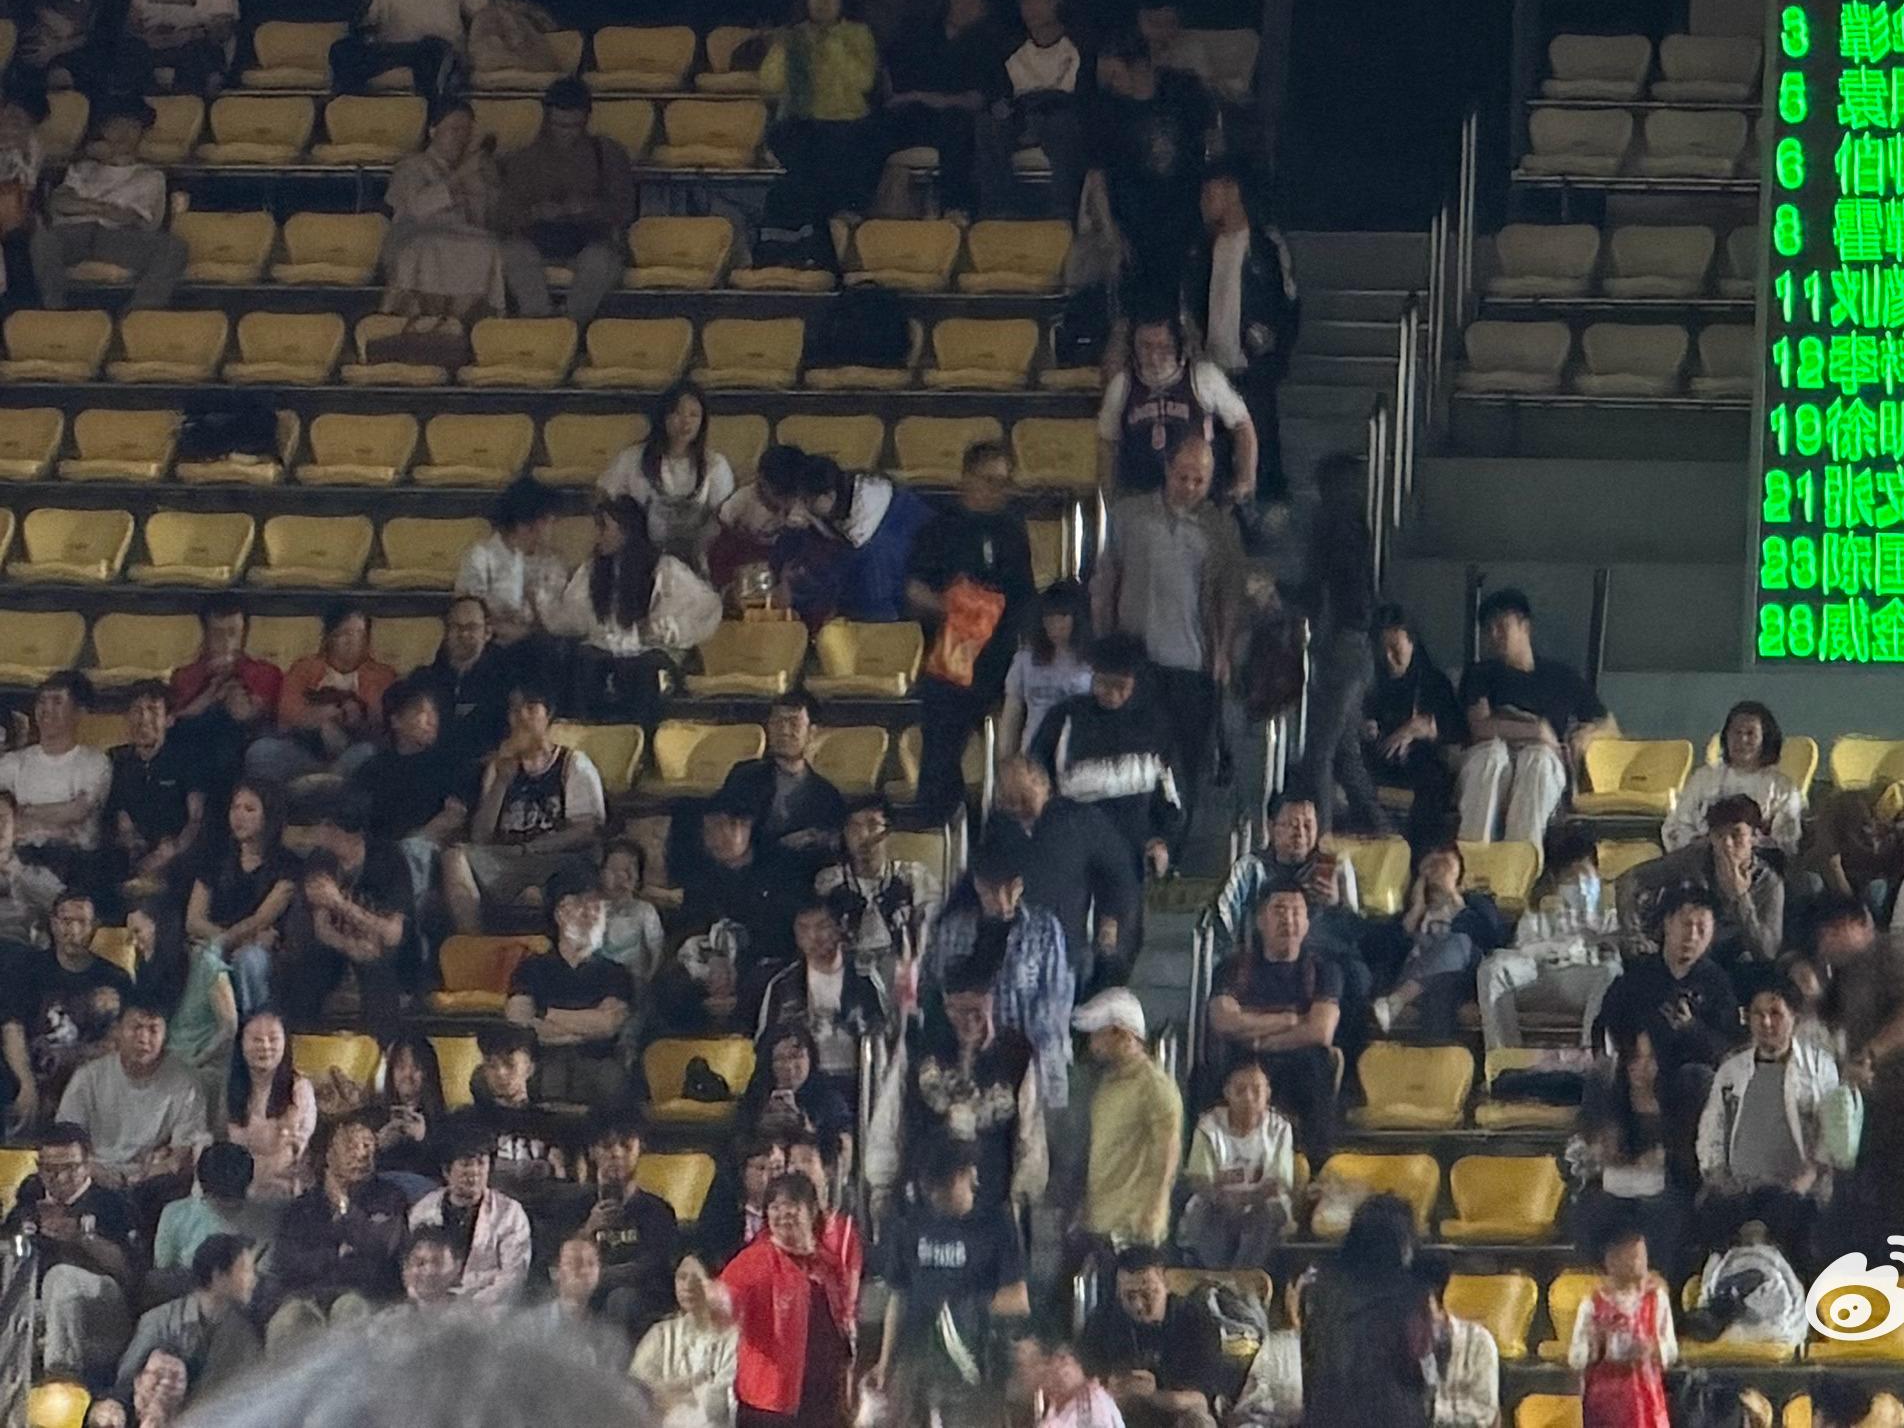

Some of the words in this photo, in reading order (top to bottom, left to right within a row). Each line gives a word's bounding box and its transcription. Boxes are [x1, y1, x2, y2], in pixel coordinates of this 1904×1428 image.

[1781, 6, 1809, 58] 3
[1779, 72, 1807, 123] 5
[1776, 137, 1805, 189] 6
[1774, 204, 1802, 256] 8
[1775, 270, 1822, 322] 11
[1773, 336, 1827, 388] 12
[1771, 403, 1824, 456] 19
[1763, 469, 1814, 522] 21
[1761, 535, 1819, 589] 23
[1758, 603, 1817, 656] 28
